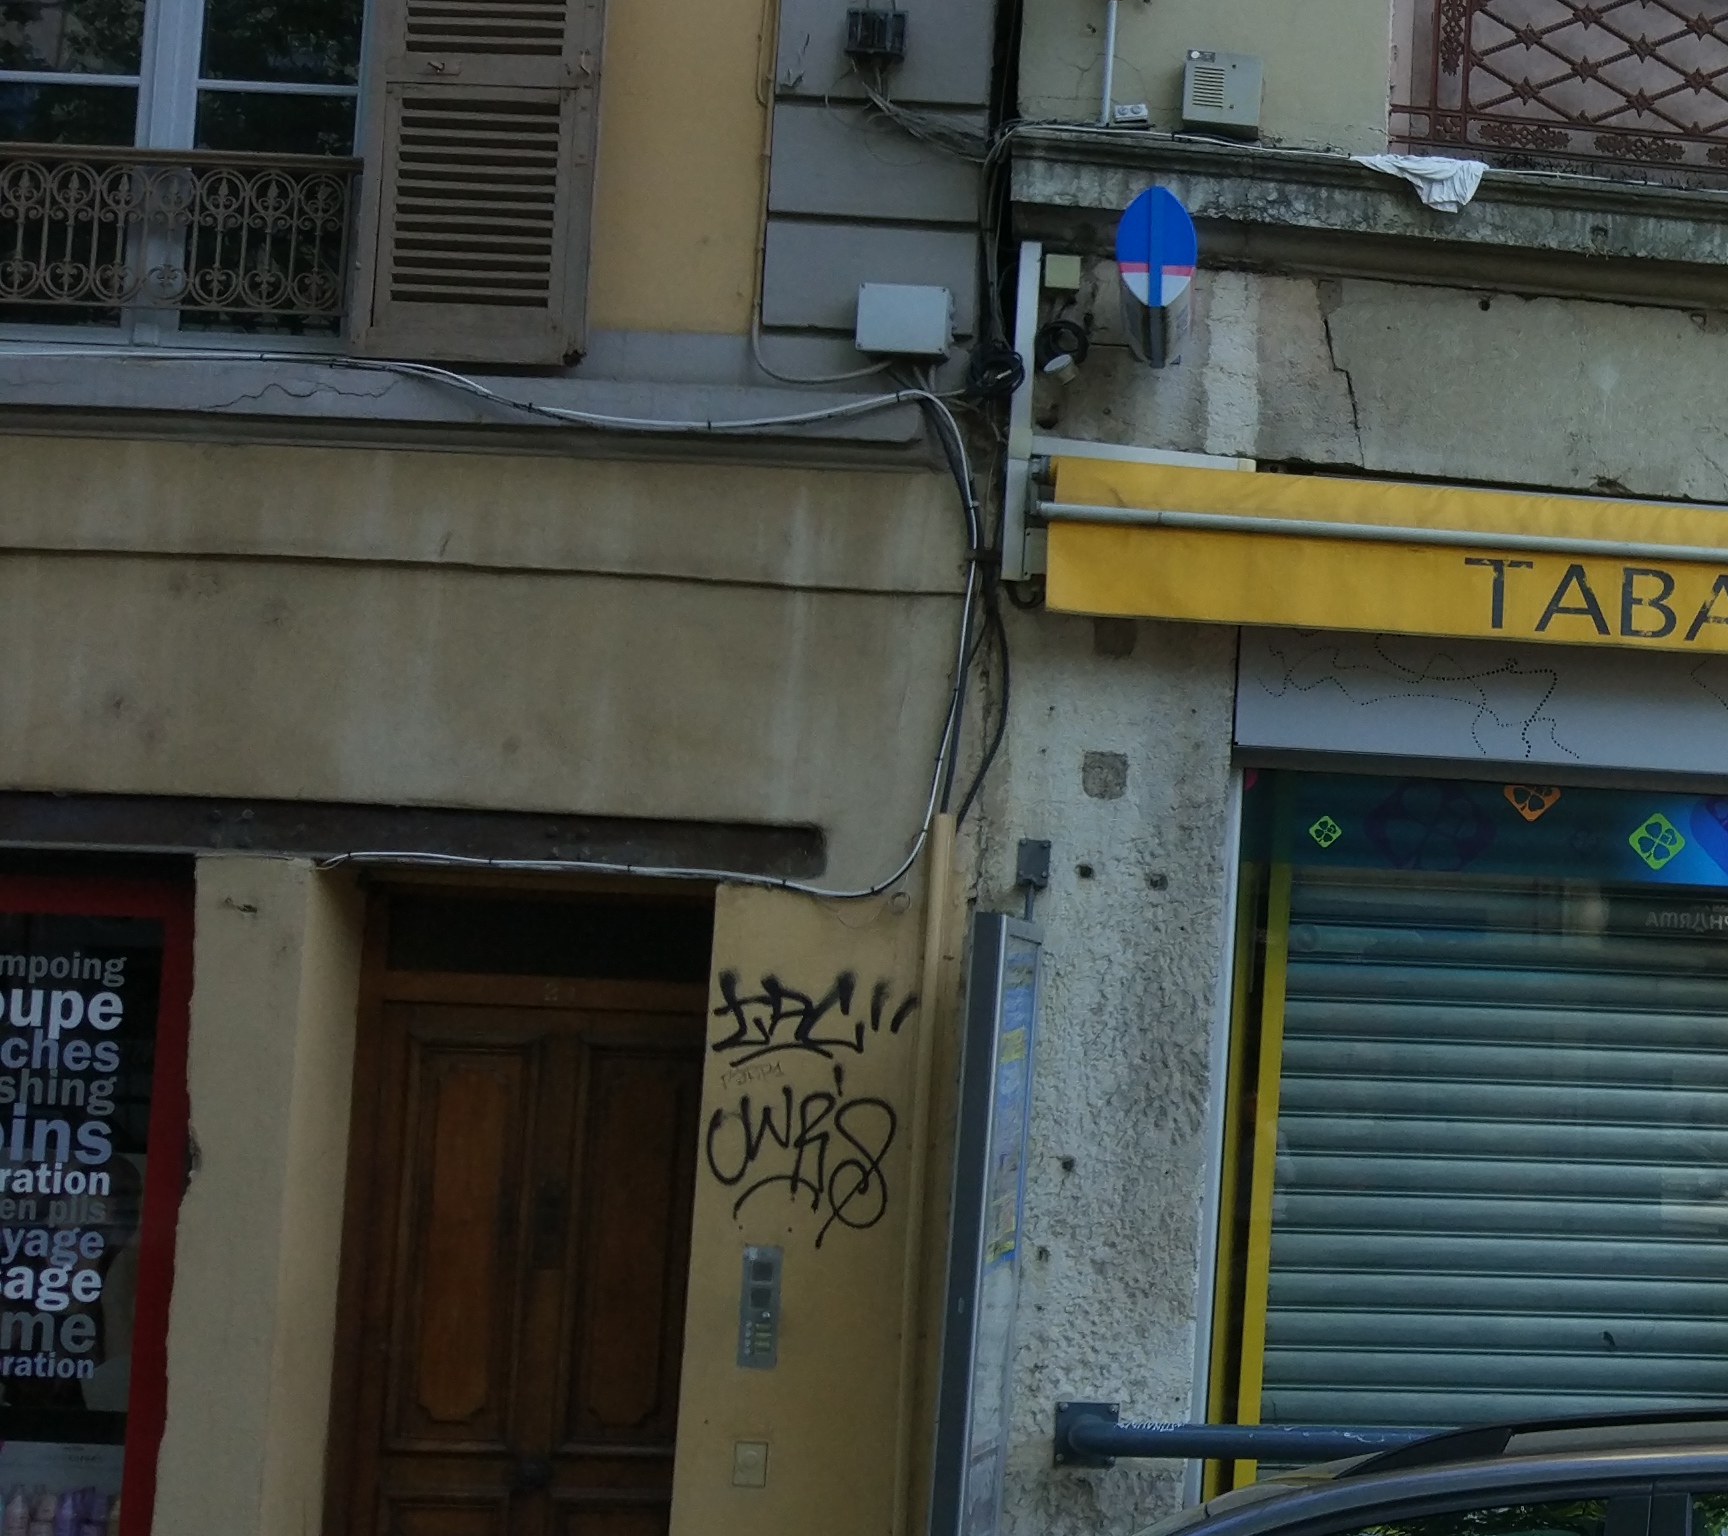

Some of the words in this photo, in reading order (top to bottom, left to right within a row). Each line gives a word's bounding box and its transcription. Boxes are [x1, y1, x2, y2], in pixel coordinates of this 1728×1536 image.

[0, 988, 123, 1039] upe
[1, 1028, 120, 1072] ches
[0, 1068, 117, 1116] shing
[0, 1102, 113, 1165] ins
[1, 1226, 105, 1265] yage
[0, 1264, 102, 1312] age
